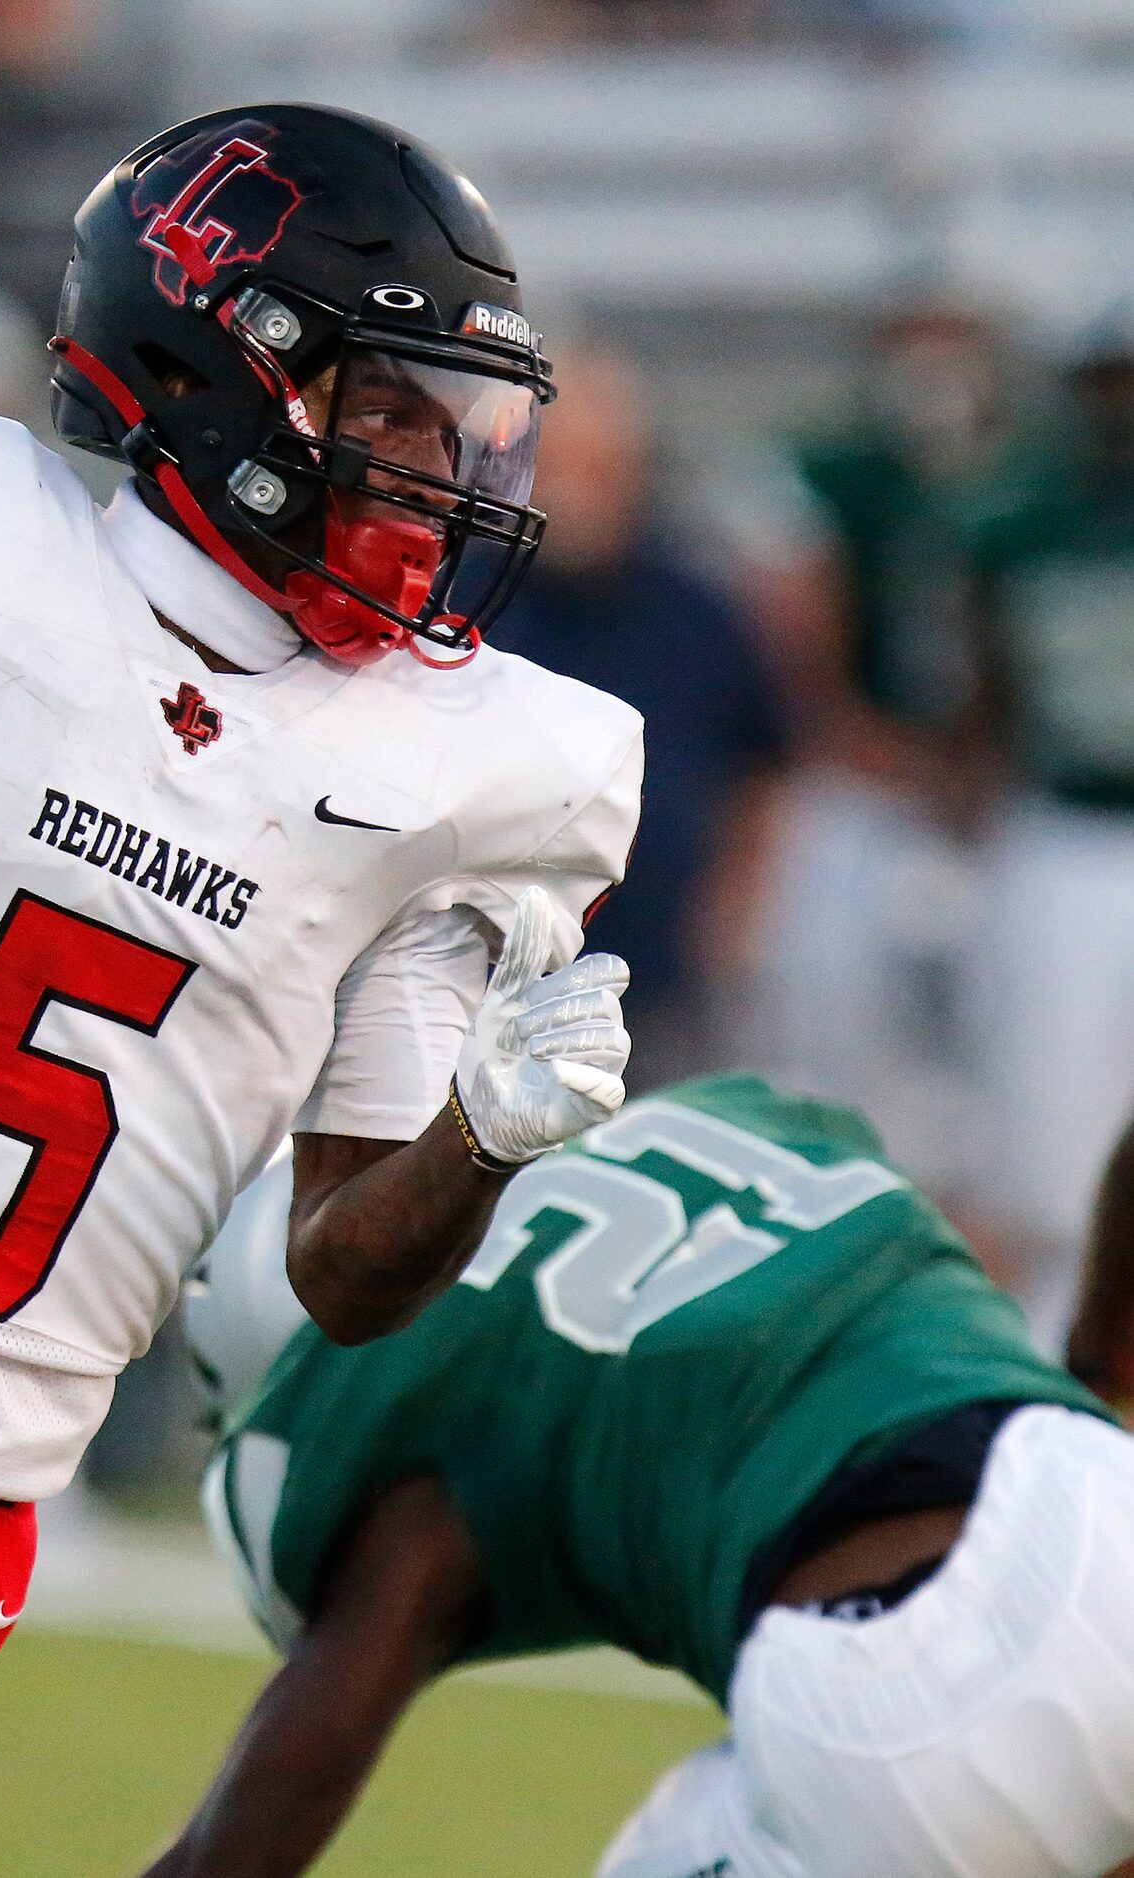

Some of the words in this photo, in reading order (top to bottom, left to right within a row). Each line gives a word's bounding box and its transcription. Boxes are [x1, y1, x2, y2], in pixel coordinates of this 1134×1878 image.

[475, 306, 531, 347] Riddell
[29, 787, 260, 930] REDHAWKS
[457, 1102, 912, 1355] 21
